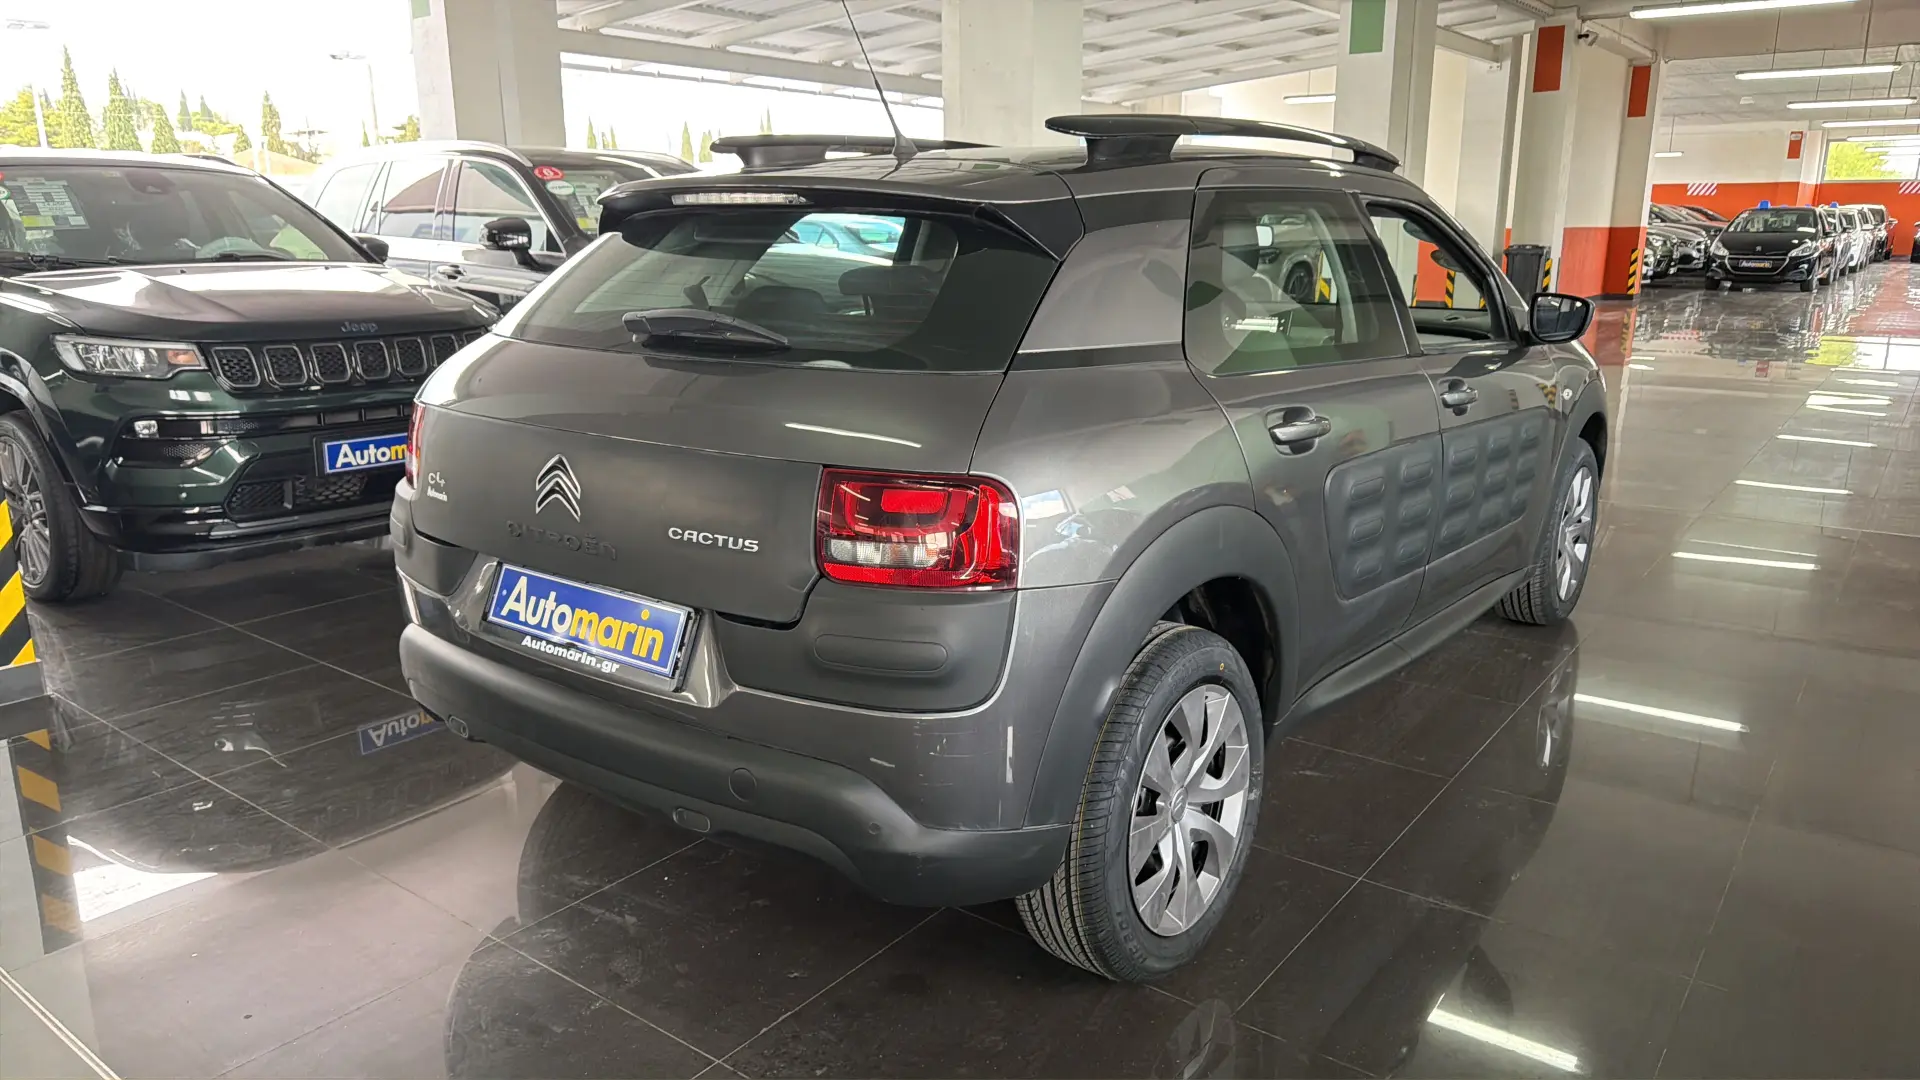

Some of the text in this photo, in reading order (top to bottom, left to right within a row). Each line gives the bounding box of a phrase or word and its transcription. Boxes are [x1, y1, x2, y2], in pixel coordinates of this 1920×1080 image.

[340, 321, 378, 333] Jeep
[335, 443, 408, 469] Autom
[428, 471, 446, 488] C4
[506, 519, 618, 561] CITROËN
[668, 527, 760, 553] CACTUS
[500, 575, 665, 662] Automarin
[521, 634, 621, 674] Automarin.gr
